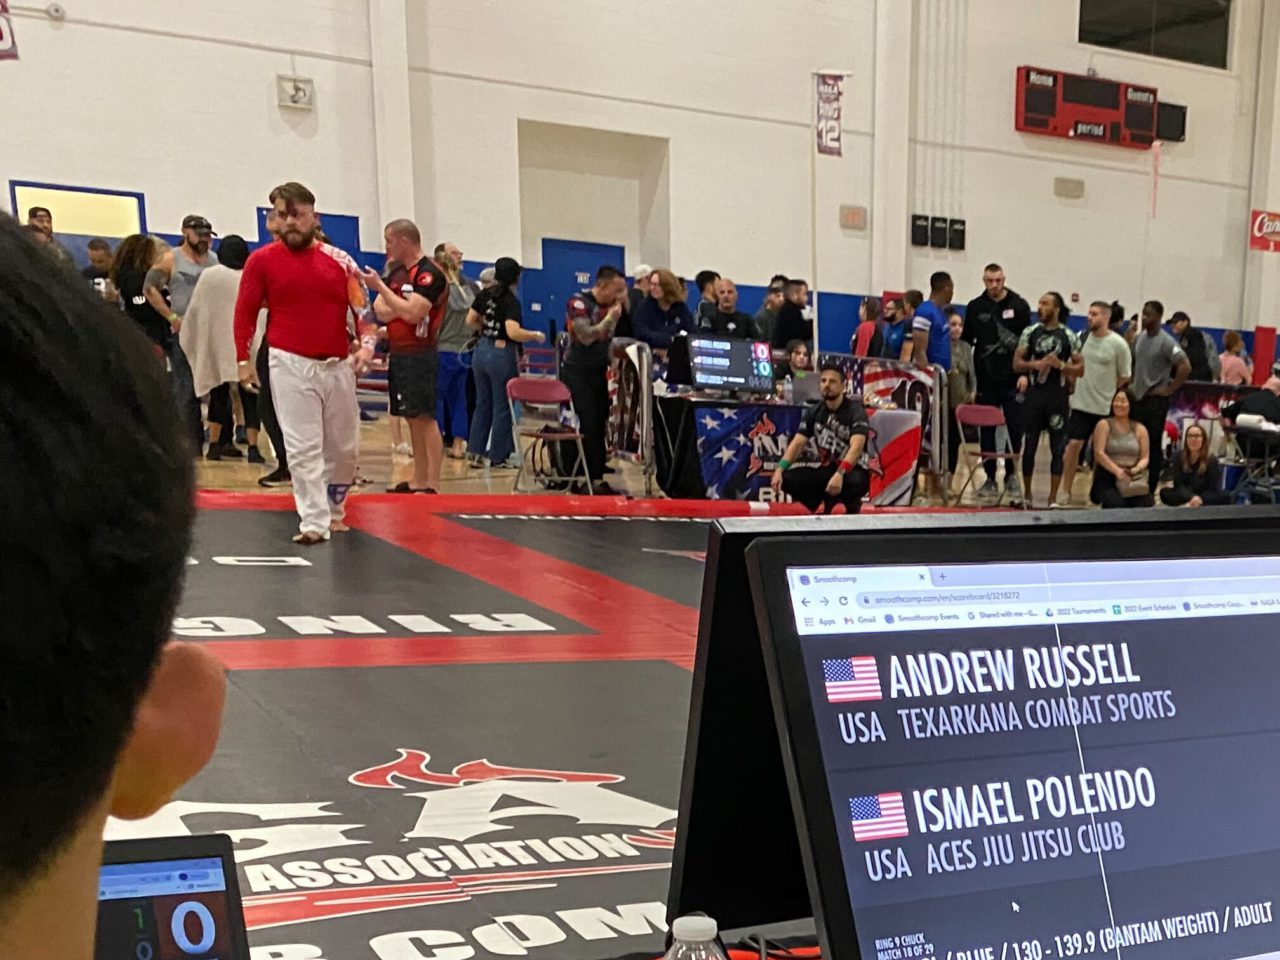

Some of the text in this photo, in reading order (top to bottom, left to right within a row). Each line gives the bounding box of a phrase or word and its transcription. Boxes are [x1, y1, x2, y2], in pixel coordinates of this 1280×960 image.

[818, 120, 840, 148] 12
[1077, 123, 1104, 136] period
[814, 574, 858, 585] Smoothcomp
[819, 617, 836, 627] Apps
[857, 615, 876, 624] Gmail
[890, 643, 1141, 699] ANDREW RUSSELL
[838, 690, 1176, 745] USA TEXARKANA COMBAT SPORTS
[913, 767, 1156, 833] ISMAEL POLENDO
[249, 833, 640, 892] ASSOCIATION
[864, 821, 1126, 881] USA ACES JIU JITSU CLUB
[170, 900, 216, 954] 0
[875, 933, 925, 950] RING 9 CHUCK
[1054, 931, 1096, 958] 139.9
[1099, 920, 1162, 953] (BANTAM
[1161, 910, 1219, 940] WEIGHT)
[1234, 901, 1273, 928] ADULT
[903, 947, 913, 958] 18
[914, 946, 924, 956] OF
[924, 944, 934, 955] 29
